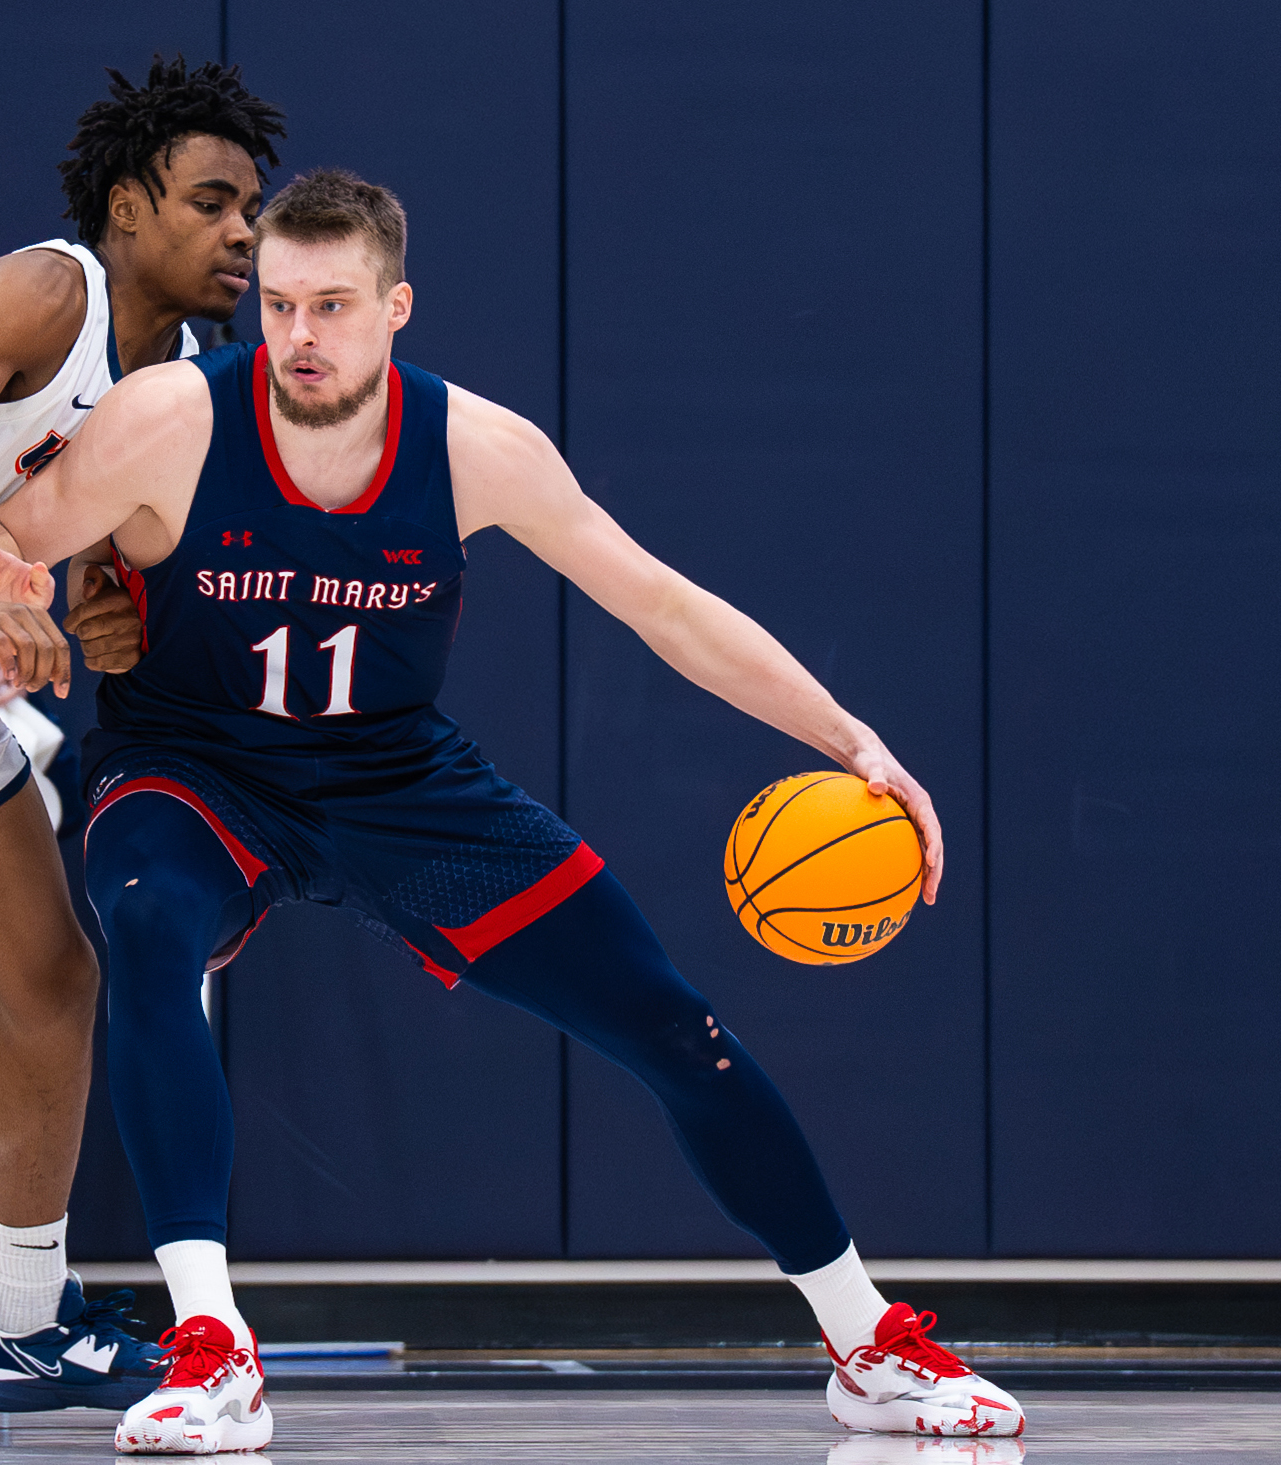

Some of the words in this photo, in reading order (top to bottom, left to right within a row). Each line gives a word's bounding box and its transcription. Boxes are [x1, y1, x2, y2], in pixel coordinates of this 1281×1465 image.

[382, 549, 423, 565] WCC
[196, 570, 297, 602] SAINT
[310, 575, 437, 609] MARY'S
[248, 623, 363, 722] 11
